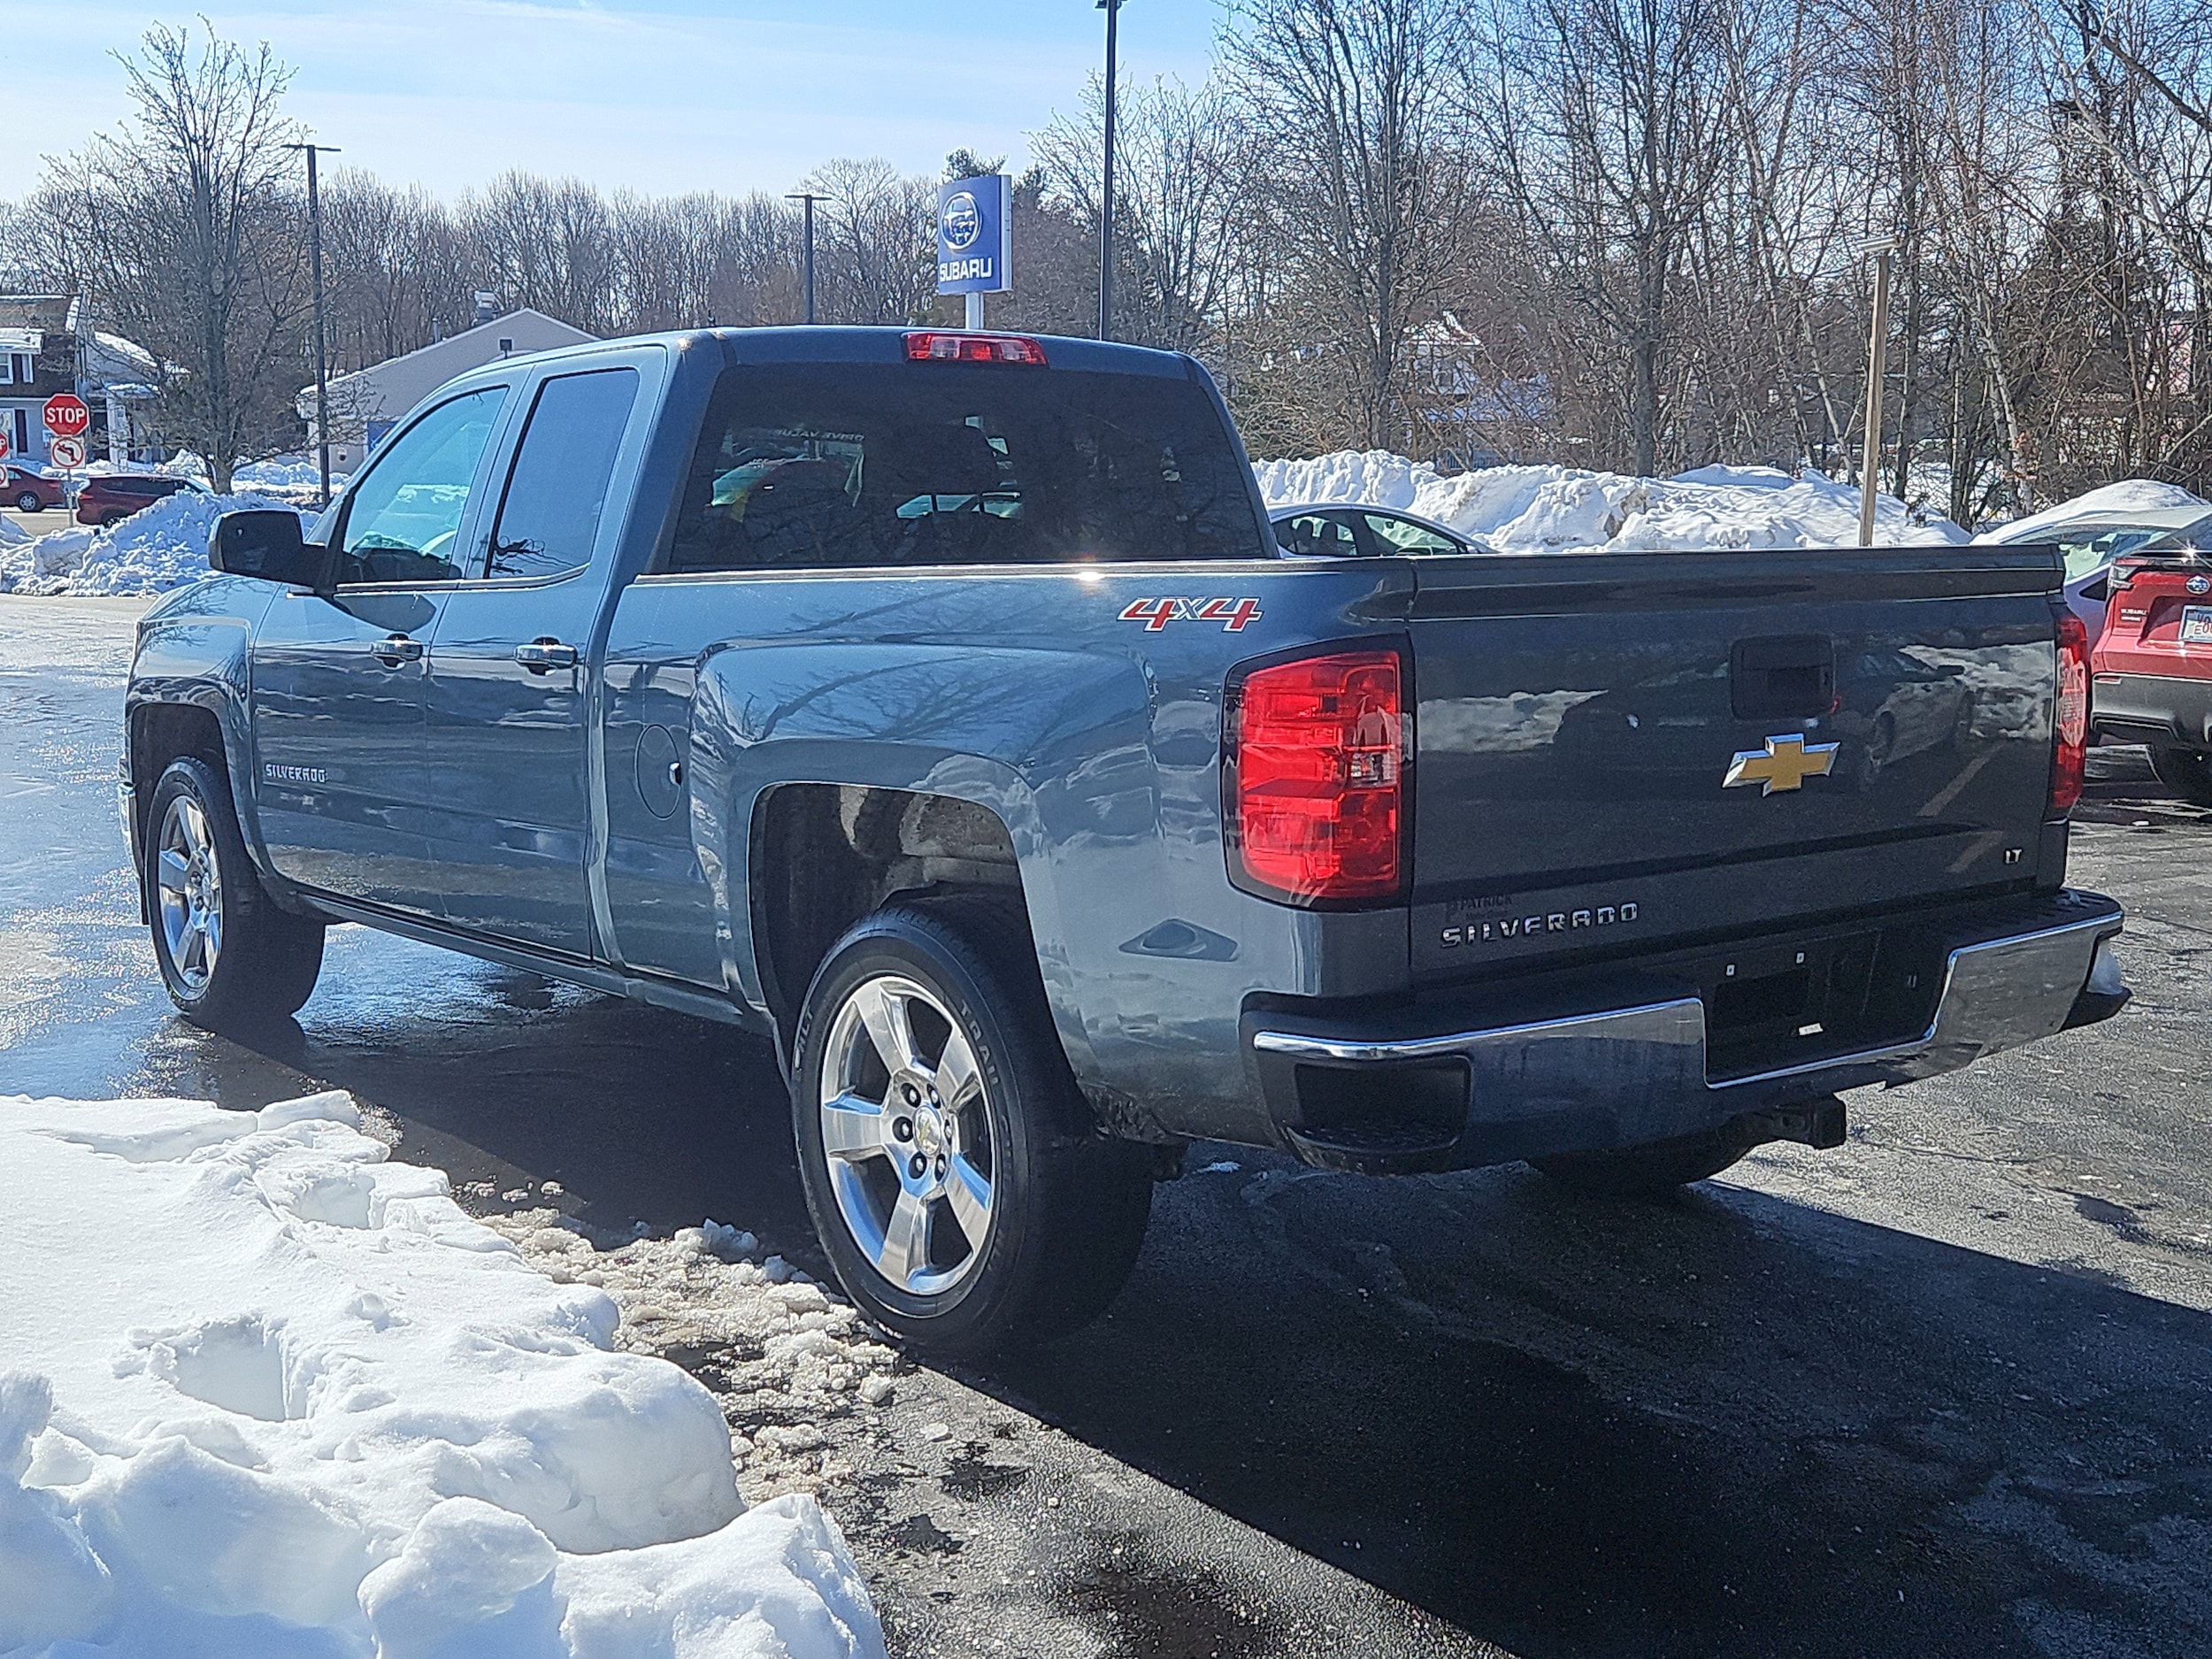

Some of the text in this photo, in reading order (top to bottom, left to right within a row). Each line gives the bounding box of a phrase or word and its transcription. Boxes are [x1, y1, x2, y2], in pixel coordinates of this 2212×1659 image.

[939, 257, 993, 282] SUBARU
[46, 407, 86, 424] STOP
[1117, 596, 1265, 633] 4X4
[265, 763, 326, 784] SILVERADO
[2004, 849, 2023, 864] LT
[1441, 902, 1638, 949] SILVERADO
